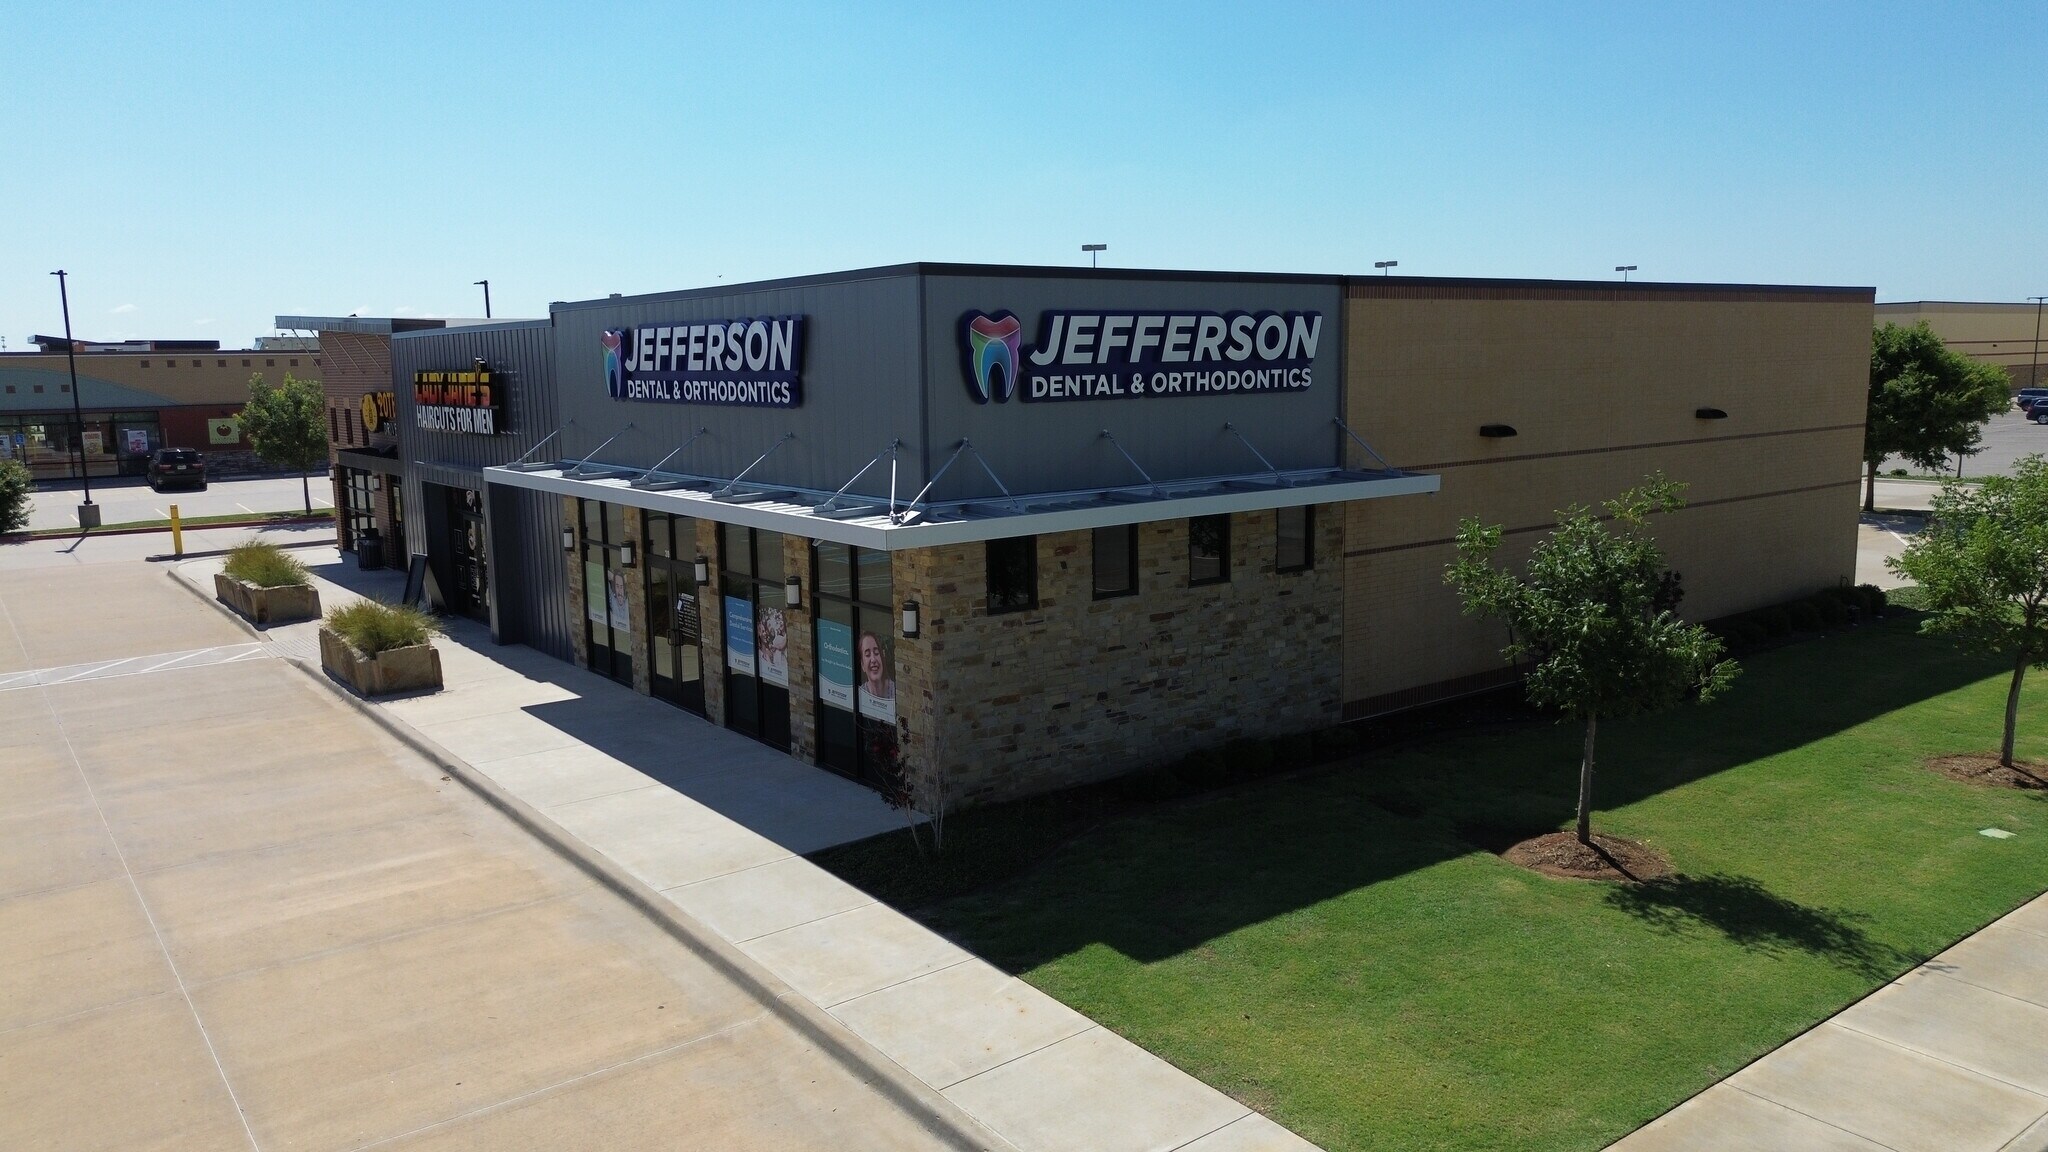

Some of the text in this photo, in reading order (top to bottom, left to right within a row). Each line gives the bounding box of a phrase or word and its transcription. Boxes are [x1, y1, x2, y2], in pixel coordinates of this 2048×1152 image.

[624, 319, 794, 372] JEFFERSON
[1029, 315, 1323, 365] JEFFERSON
[627, 379, 791, 404] DENTAL & ORTHODONTICS
[1031, 368, 1313, 398] DENTAL & ORTHODONTICS
[416, 405, 494, 435] HAIRCUTS FOR MEN
